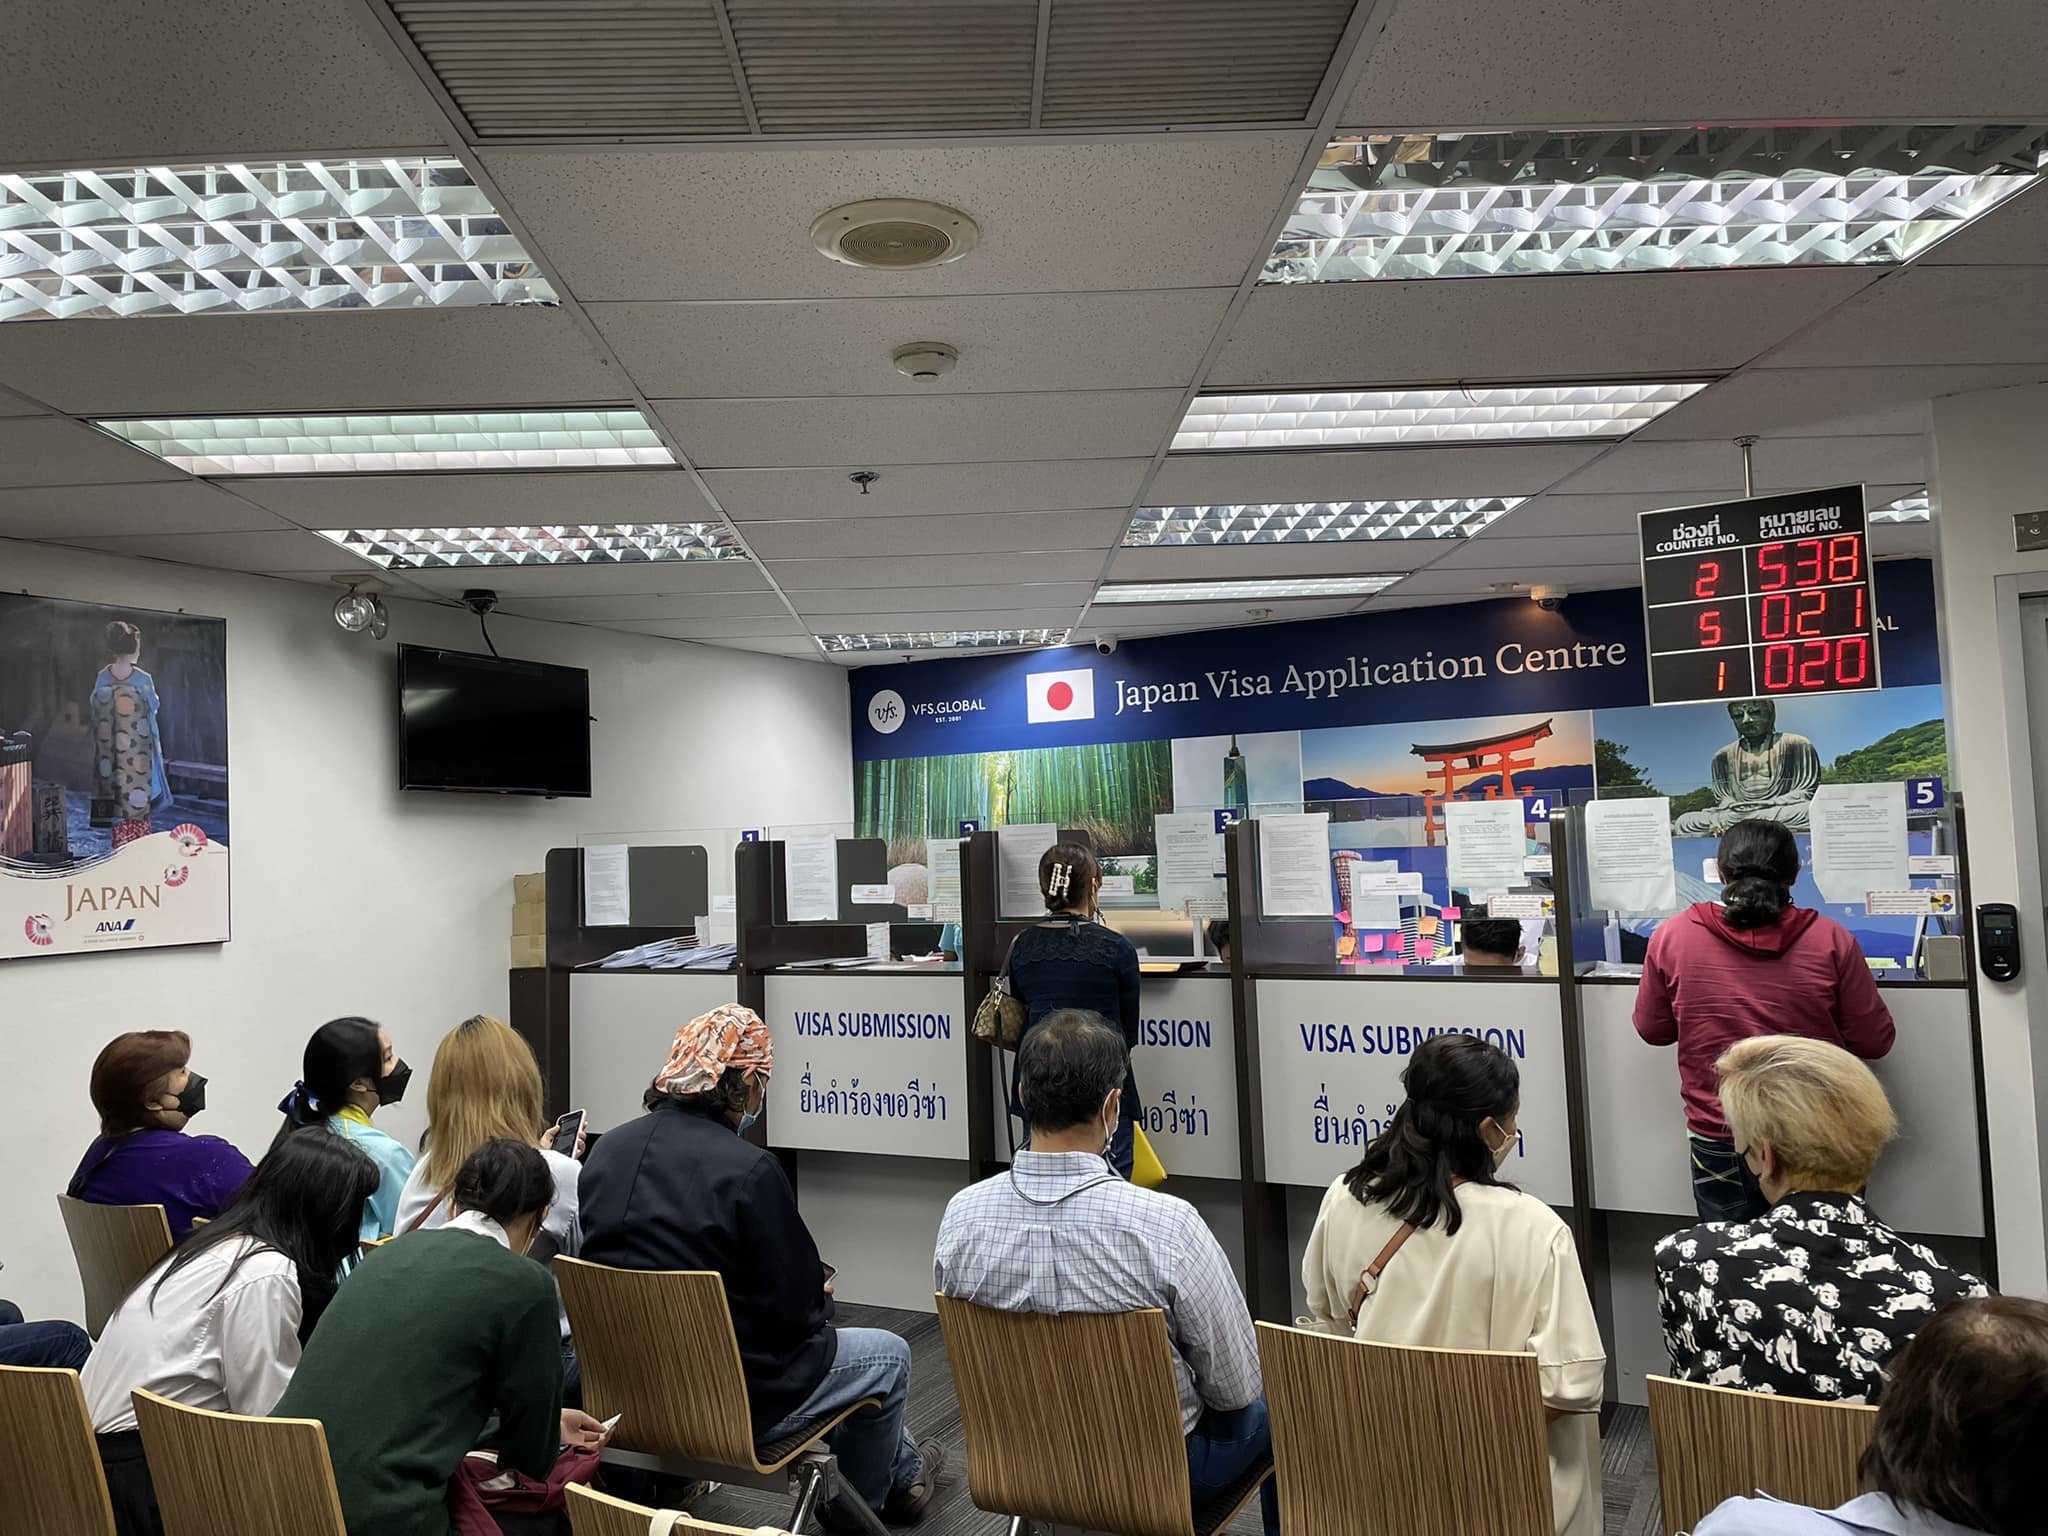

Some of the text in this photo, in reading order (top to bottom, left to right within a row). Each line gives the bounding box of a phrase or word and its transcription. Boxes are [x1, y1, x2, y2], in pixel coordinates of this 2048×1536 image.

[1672, 514, 1721, 541] ช่องที่
[1759, 520, 1842, 539] CALLING NO.
[1656, 533, 1740, 553] COUNTER NO.
[1758, 535, 1859, 591] 538
[1695, 562, 1720, 598] 2
[1698, 610, 1722, 646] 5
[1761, 588, 1863, 640] 021
[1115, 641, 1627, 715] Japan Visa Application Centre
[1716, 661, 1726, 692] 1
[1764, 637, 1867, 689] 020
[912, 698, 986, 715] VFS.GLOBAL
[1916, 781, 1935, 805] 5
[1530, 799, 1547, 819] 4
[64, 884, 161, 921] JAPAN
[96, 920, 122, 932] ANA
[794, 1012, 951, 1039] VISA SUBMISSION
[1140, 1019, 1211, 1047] ISSION
[1300, 1023, 1356, 1053] VISA
[800, 1062, 946, 1120] ยื่นคำร้องขอวีซ่า
